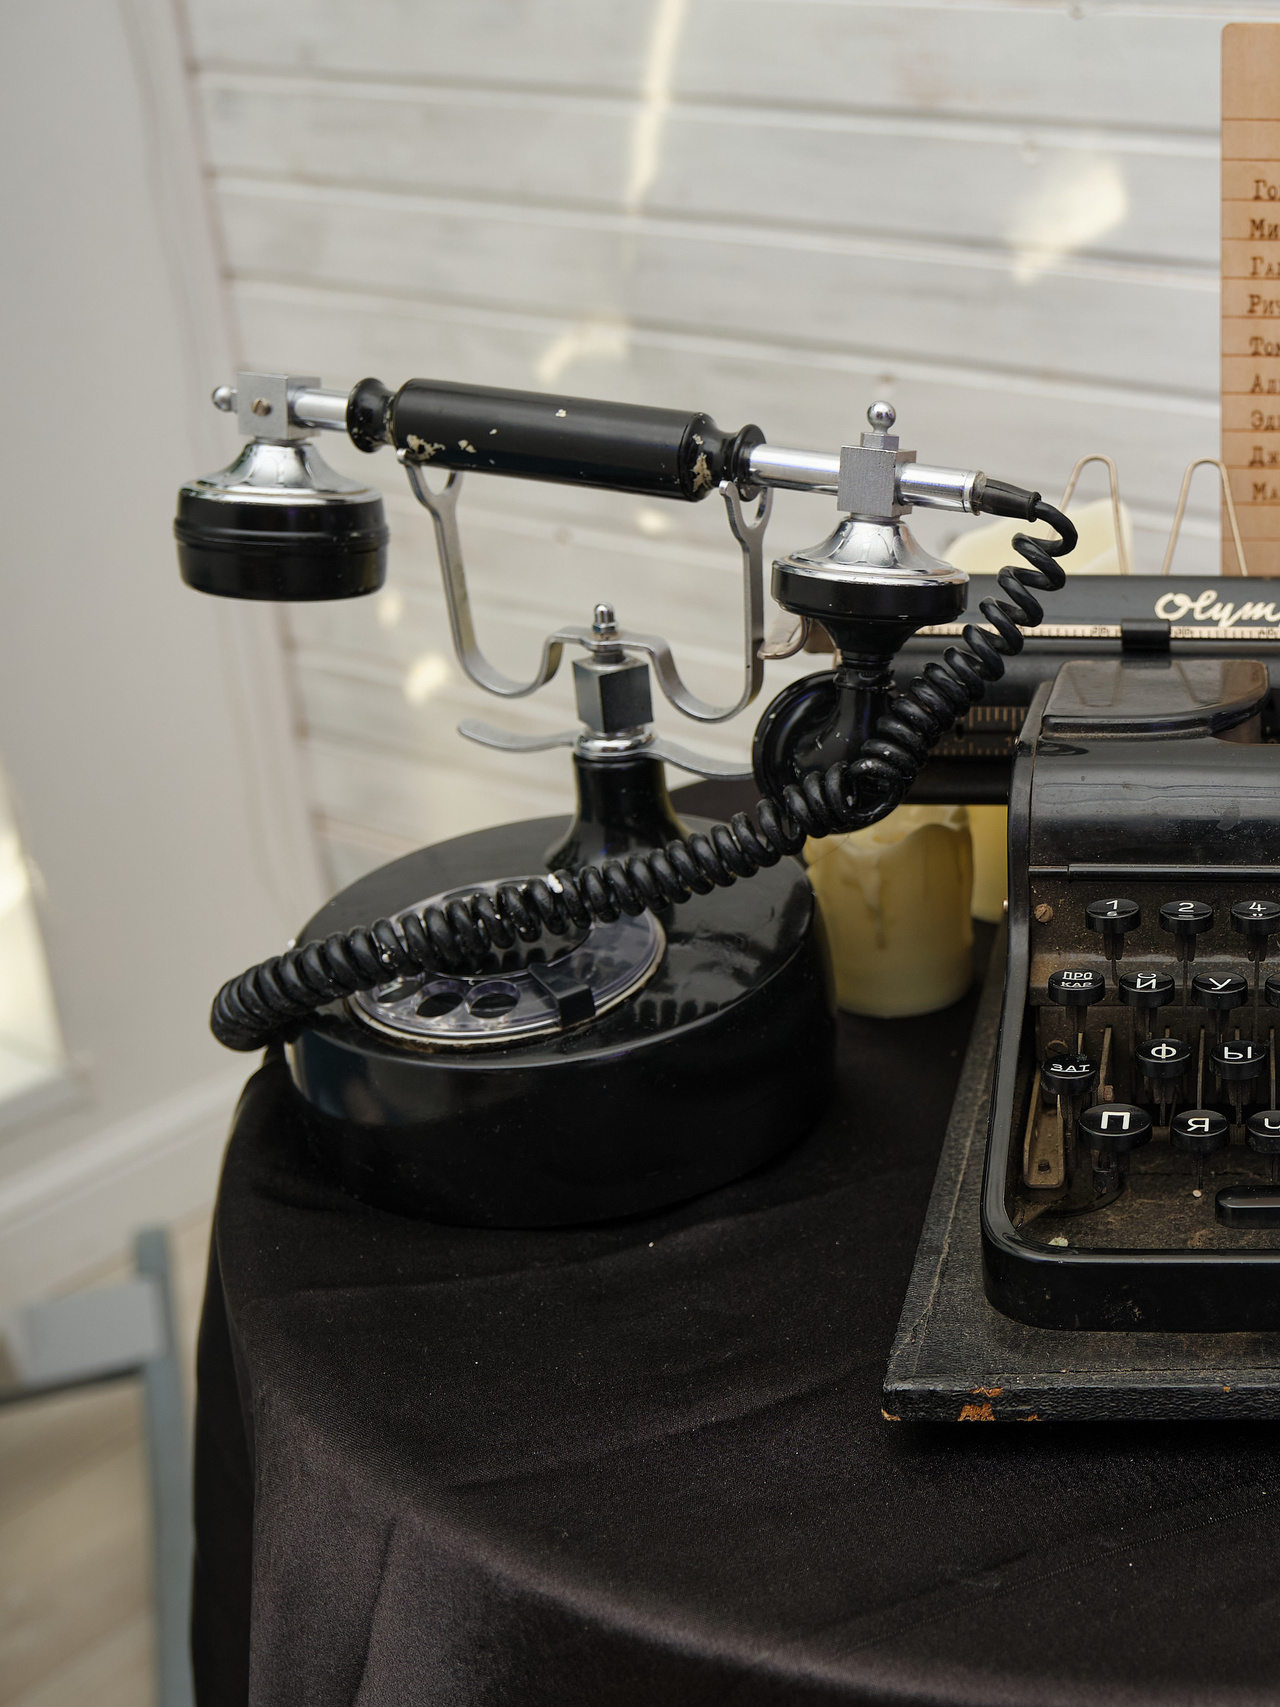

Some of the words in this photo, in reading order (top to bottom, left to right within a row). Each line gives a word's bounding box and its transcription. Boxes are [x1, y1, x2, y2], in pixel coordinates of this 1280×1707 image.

[1105, 900, 1119, 910] 1
[1178, 902, 1195, 913] 2
[1248, 901, 1267, 913] 4
[1136, 972, 1157, 989] Й
[1208, 977, 1232, 990] У
[1150, 1043, 1177, 1060] Ф
[1223, 1046, 1253, 1060] Ы
[1100, 1111, 1131, 1130] П
[1187, 1117, 1210, 1132] Я
